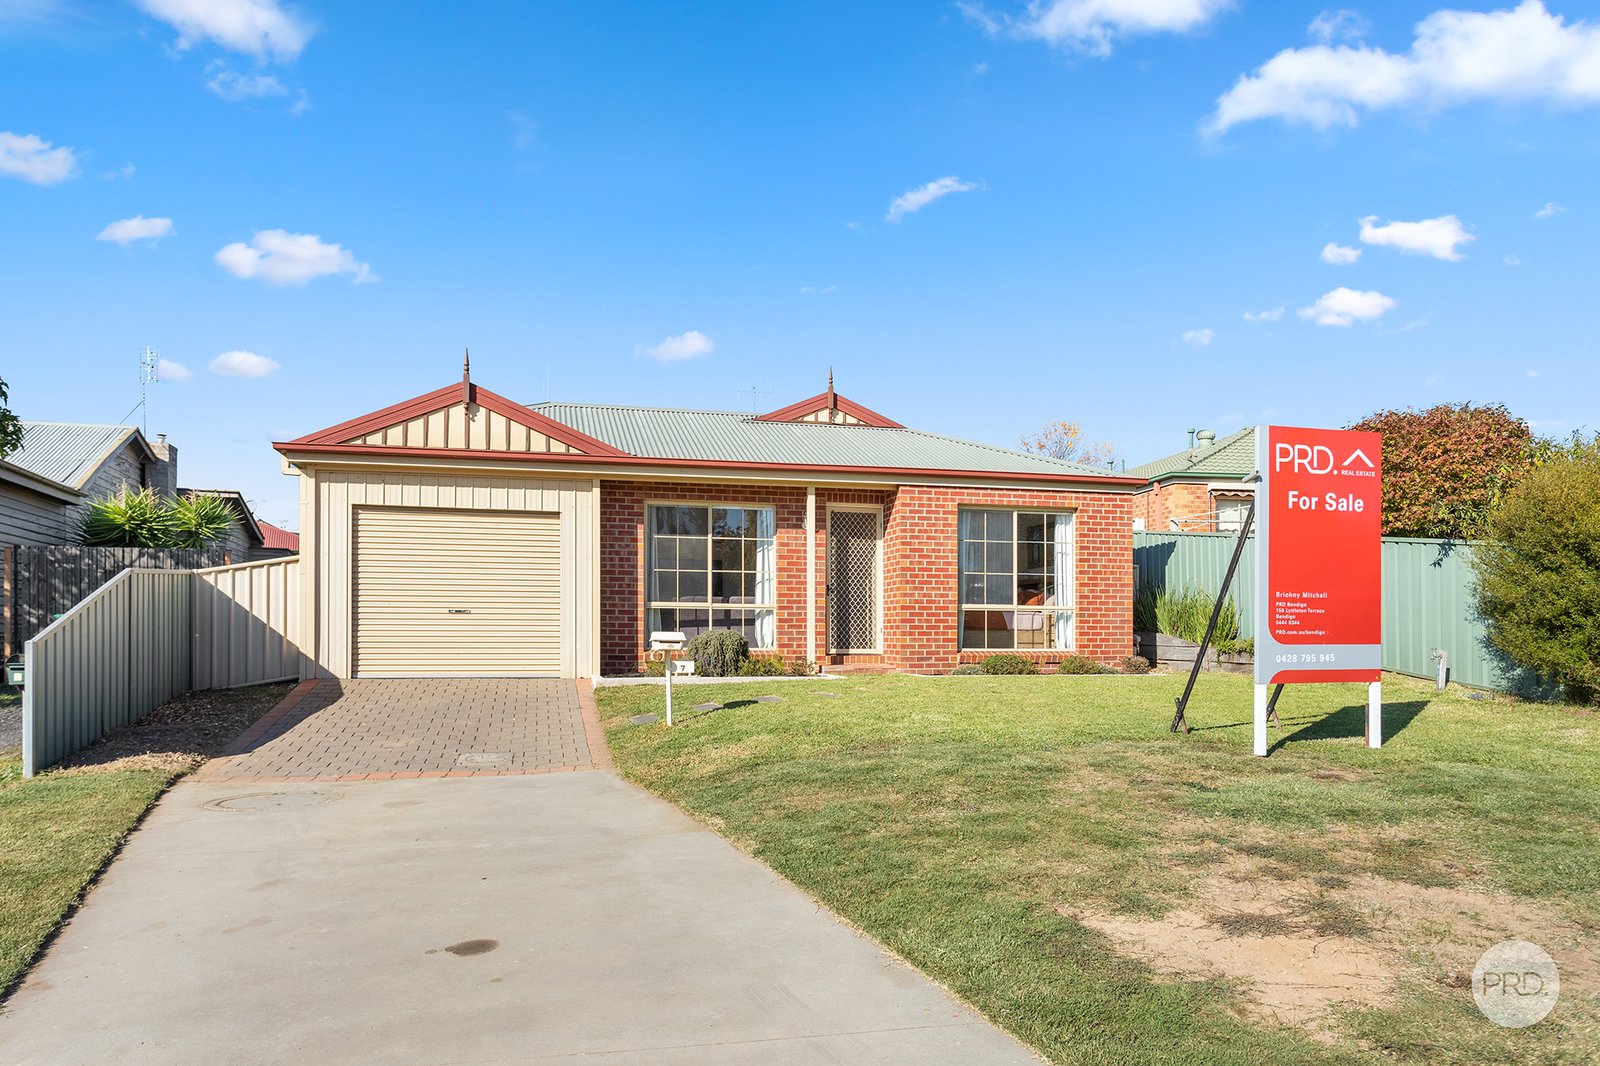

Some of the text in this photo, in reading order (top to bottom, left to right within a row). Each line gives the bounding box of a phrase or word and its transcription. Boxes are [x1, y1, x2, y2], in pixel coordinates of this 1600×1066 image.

[1288, 490, 1364, 512] For Sale
[1275, 591, 1300, 599] Briohny
[1275, 653, 1336, 662] 0428 795 945
